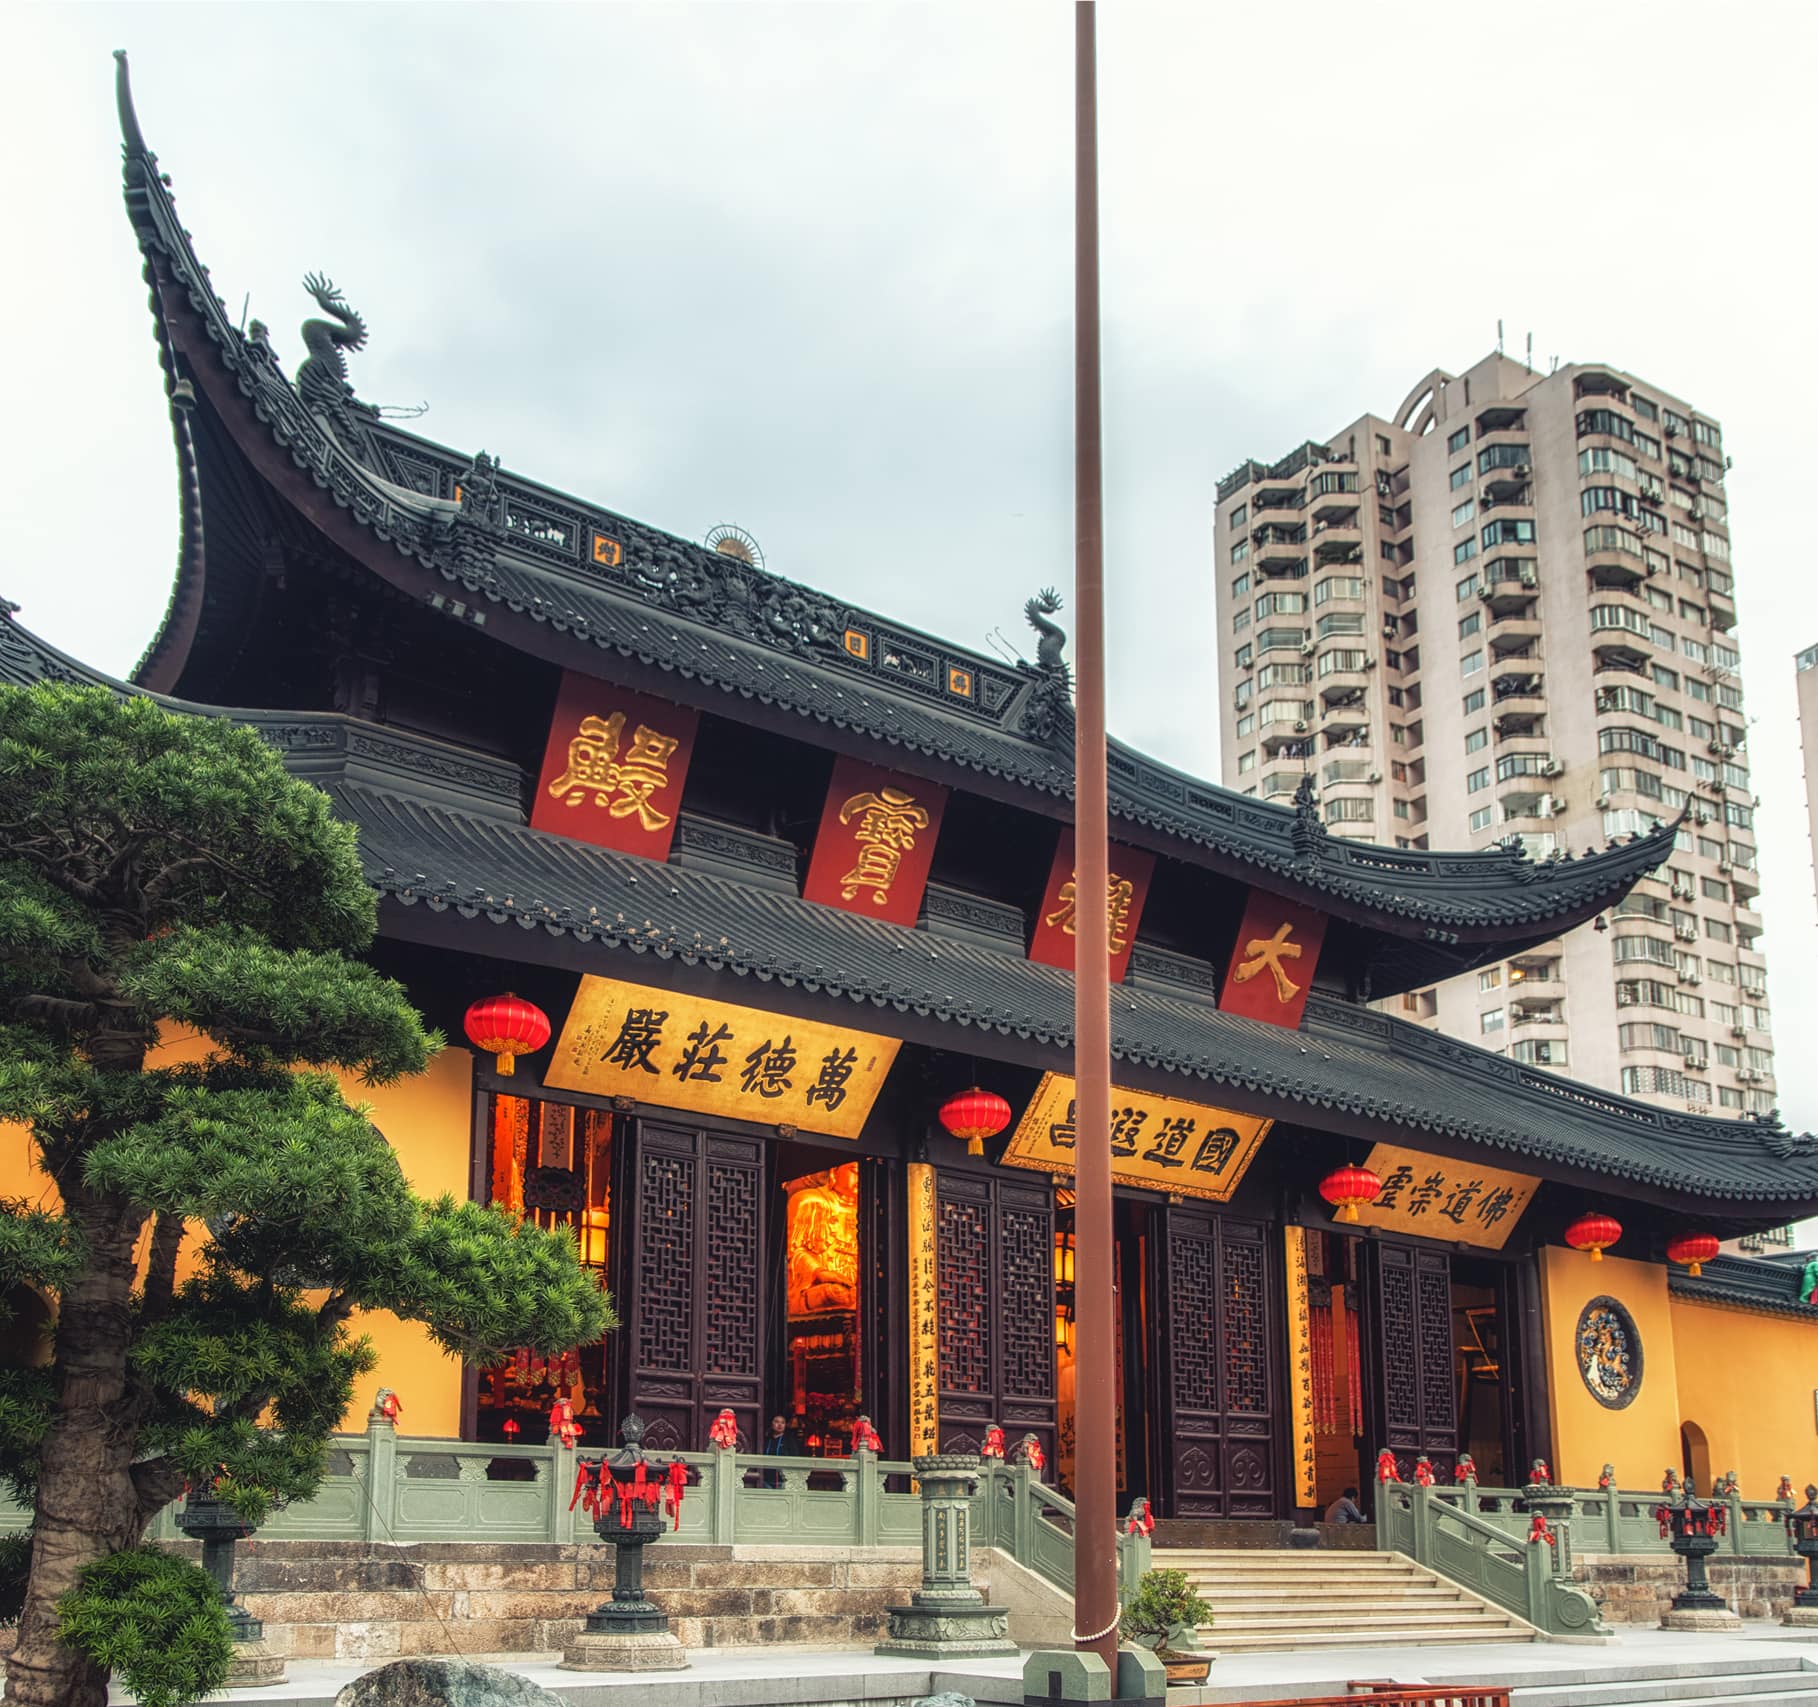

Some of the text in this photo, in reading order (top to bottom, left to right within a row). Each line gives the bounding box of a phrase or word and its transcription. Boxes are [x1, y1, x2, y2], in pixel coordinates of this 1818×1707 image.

[1232, 921, 1303, 1004] 大
[599, 1006, 859, 1113] 萬德莊嚴
